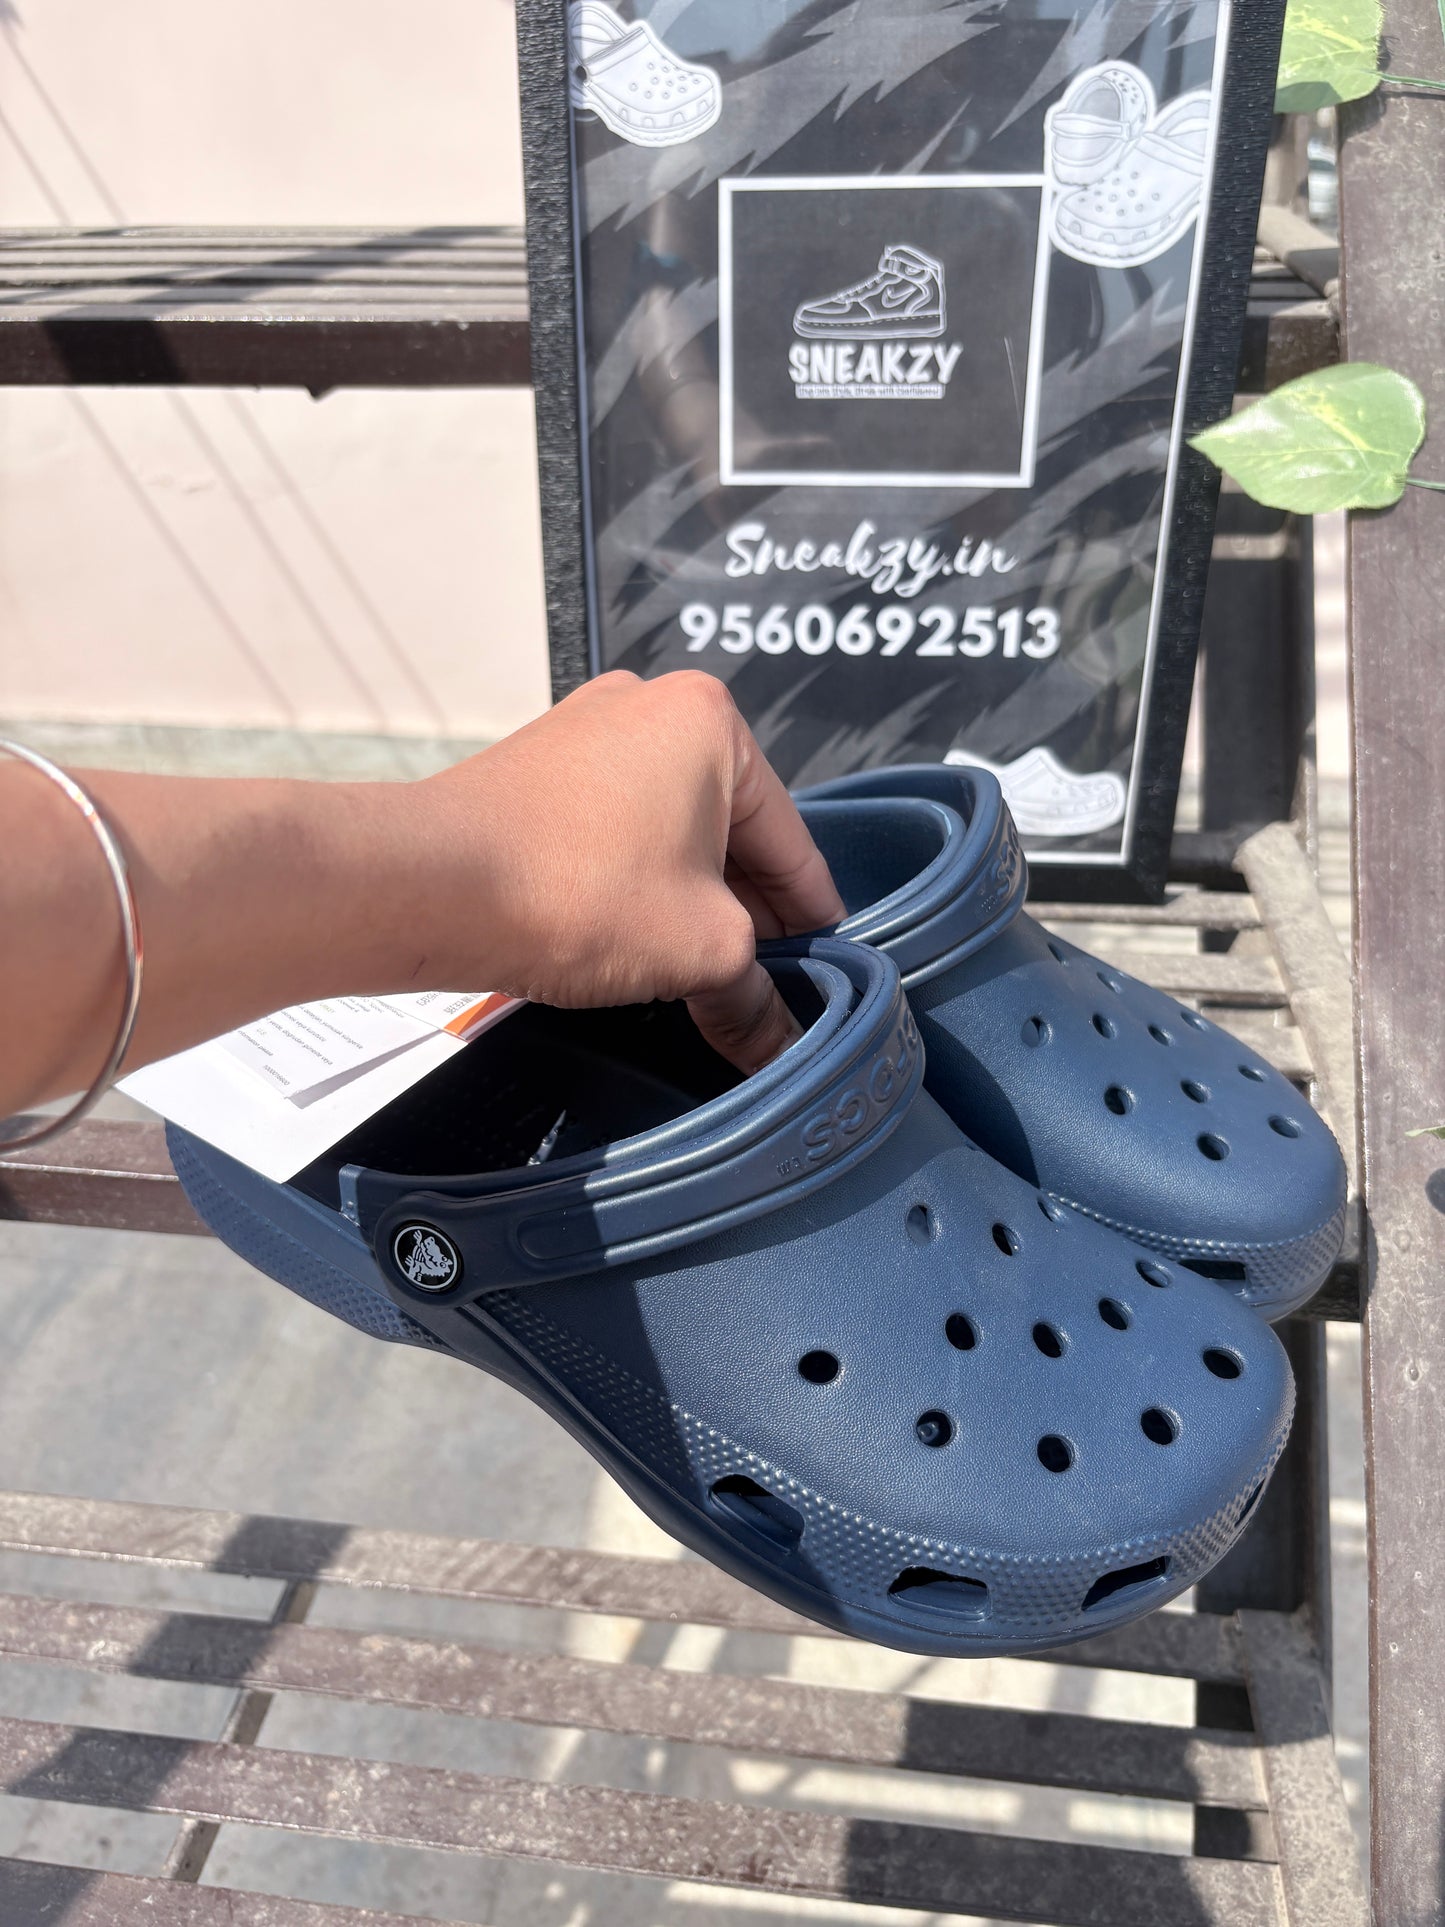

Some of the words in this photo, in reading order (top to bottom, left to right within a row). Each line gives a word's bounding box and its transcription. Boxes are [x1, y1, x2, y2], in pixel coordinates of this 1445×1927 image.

[788, 341, 963, 384] SNEAKZY
[724, 519, 1019, 598] Sneakzy.in
[679, 603, 1061, 659] 9560692513
